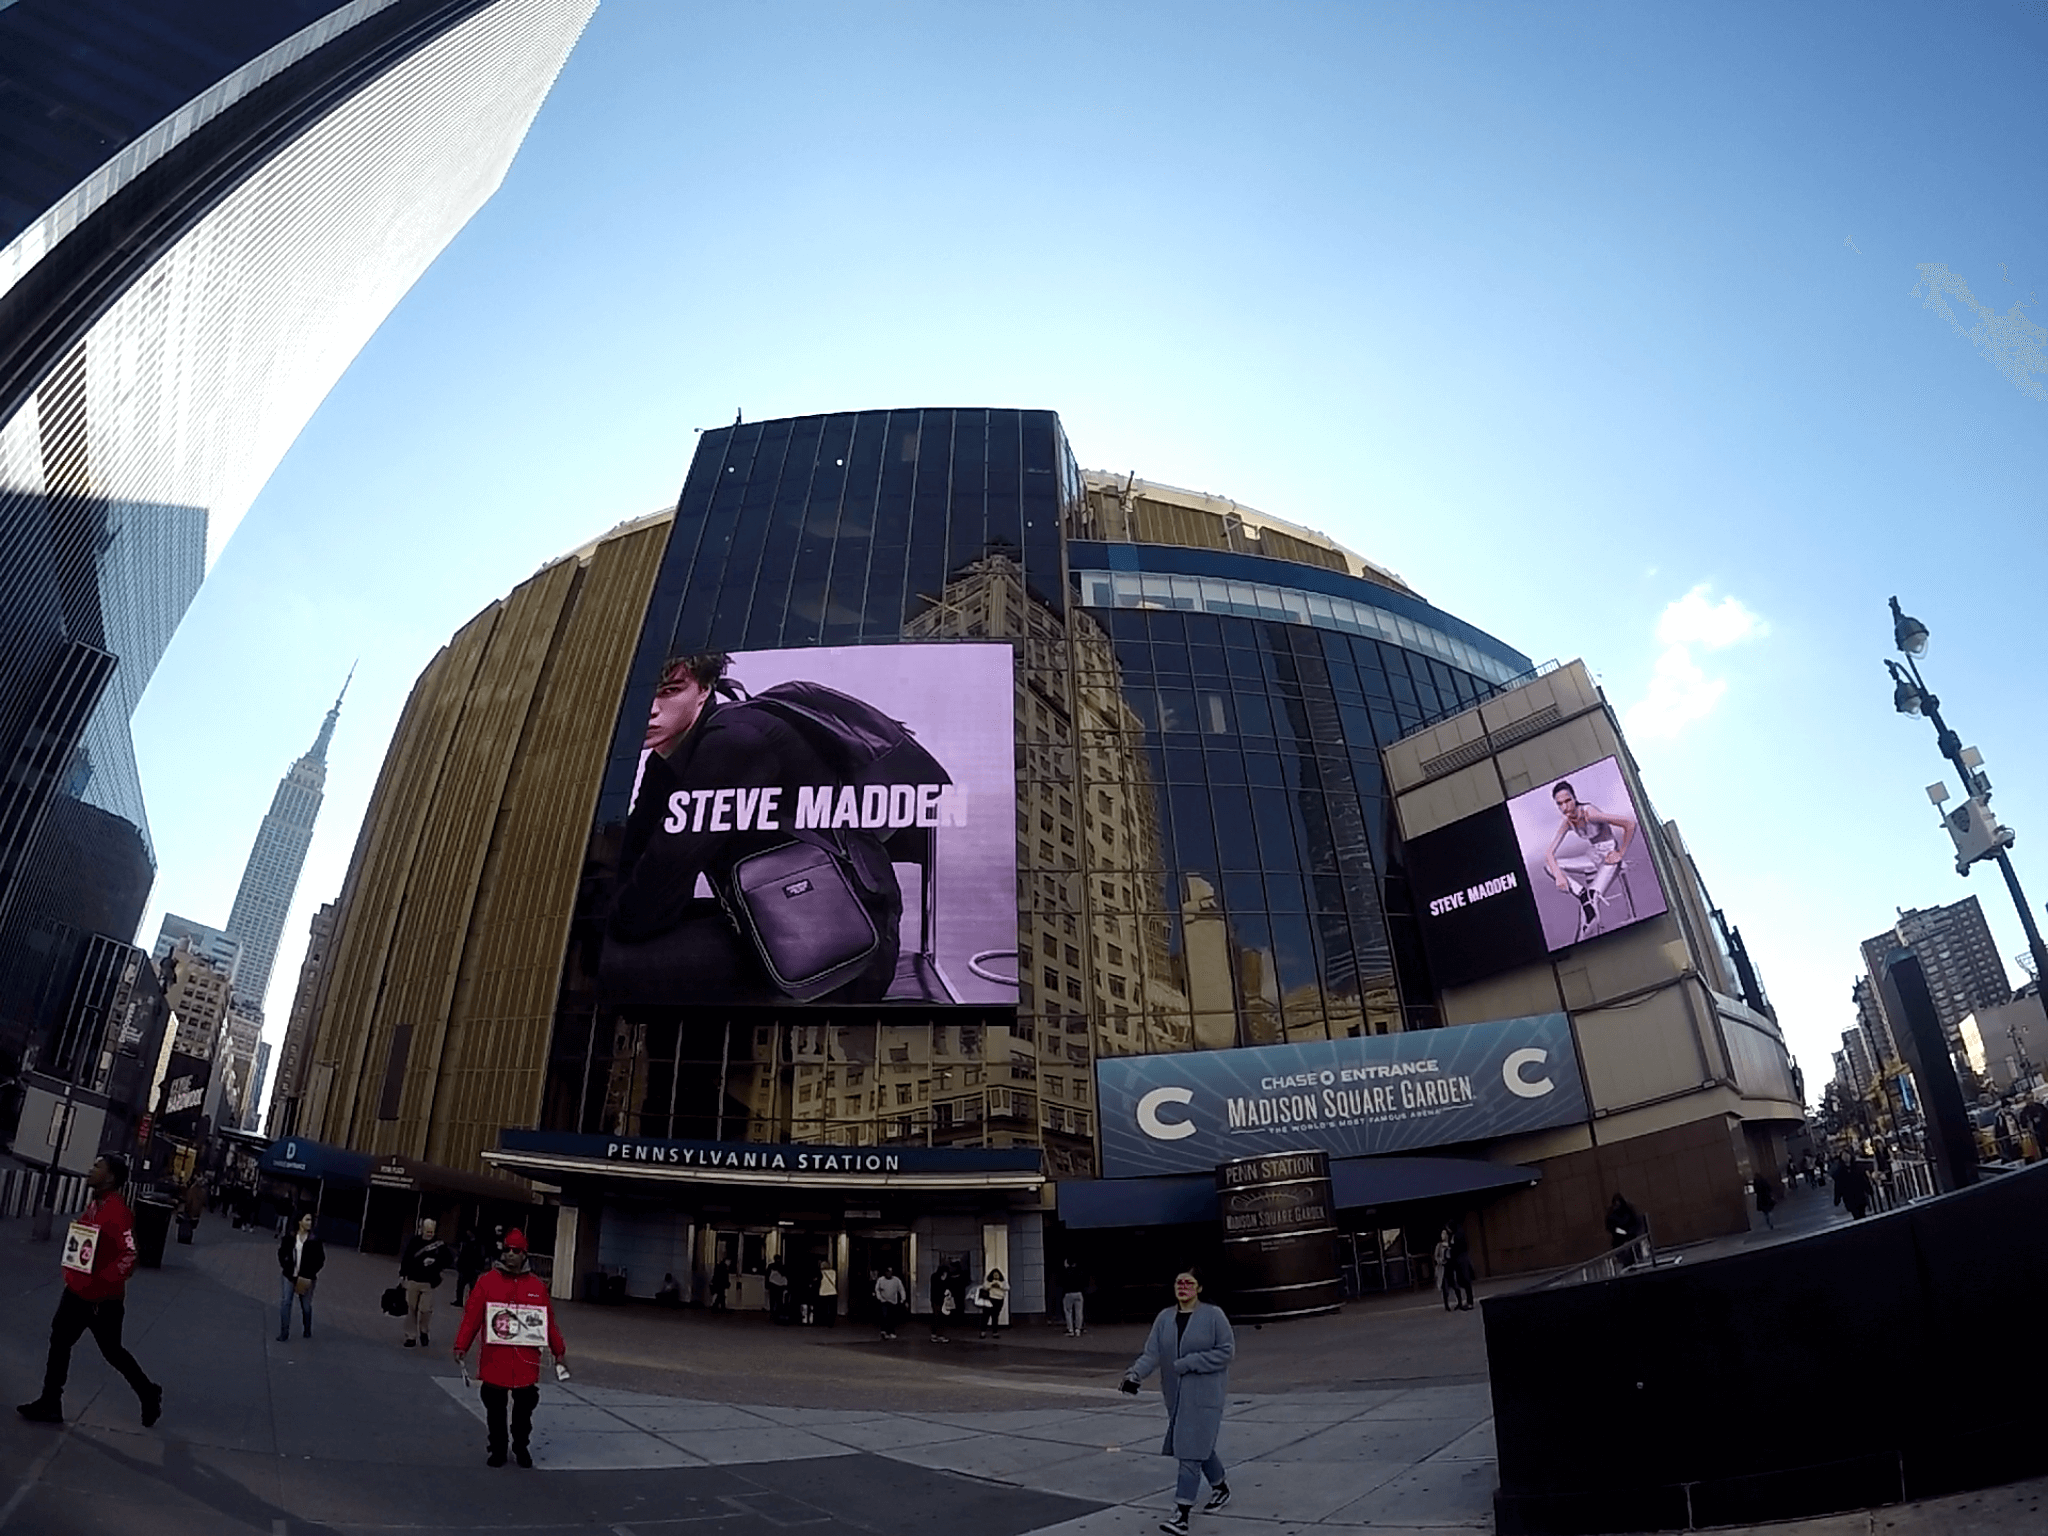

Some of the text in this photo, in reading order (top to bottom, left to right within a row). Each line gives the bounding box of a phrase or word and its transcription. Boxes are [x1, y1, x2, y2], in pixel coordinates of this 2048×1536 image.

[664, 783, 968, 834] STEVE MADDEN
[1429, 872, 1517, 916] STEVE MADDEN
[1261, 1058, 1440, 1091] CHASE ENTRANCE
[1502, 1047, 1556, 1099] C
[1136, 1087, 1197, 1141] C
[1229, 1075, 1474, 1128] MADISON SQUARE GARDEN
[1268, 1125, 1287, 1135] THE
[1291, 1120, 1336, 1133] WORLD'S
[1338, 1117, 1366, 1128] MOST
[1369, 1112, 1408, 1125] FAMOUS
[286, 1141, 297, 1160] D
[607, 1143, 900, 1171] PENNSYLVANIA STATION
[1225, 1156, 1315, 1185] PENN STATION
[1258, 1209, 1294, 1227] SQUARE
